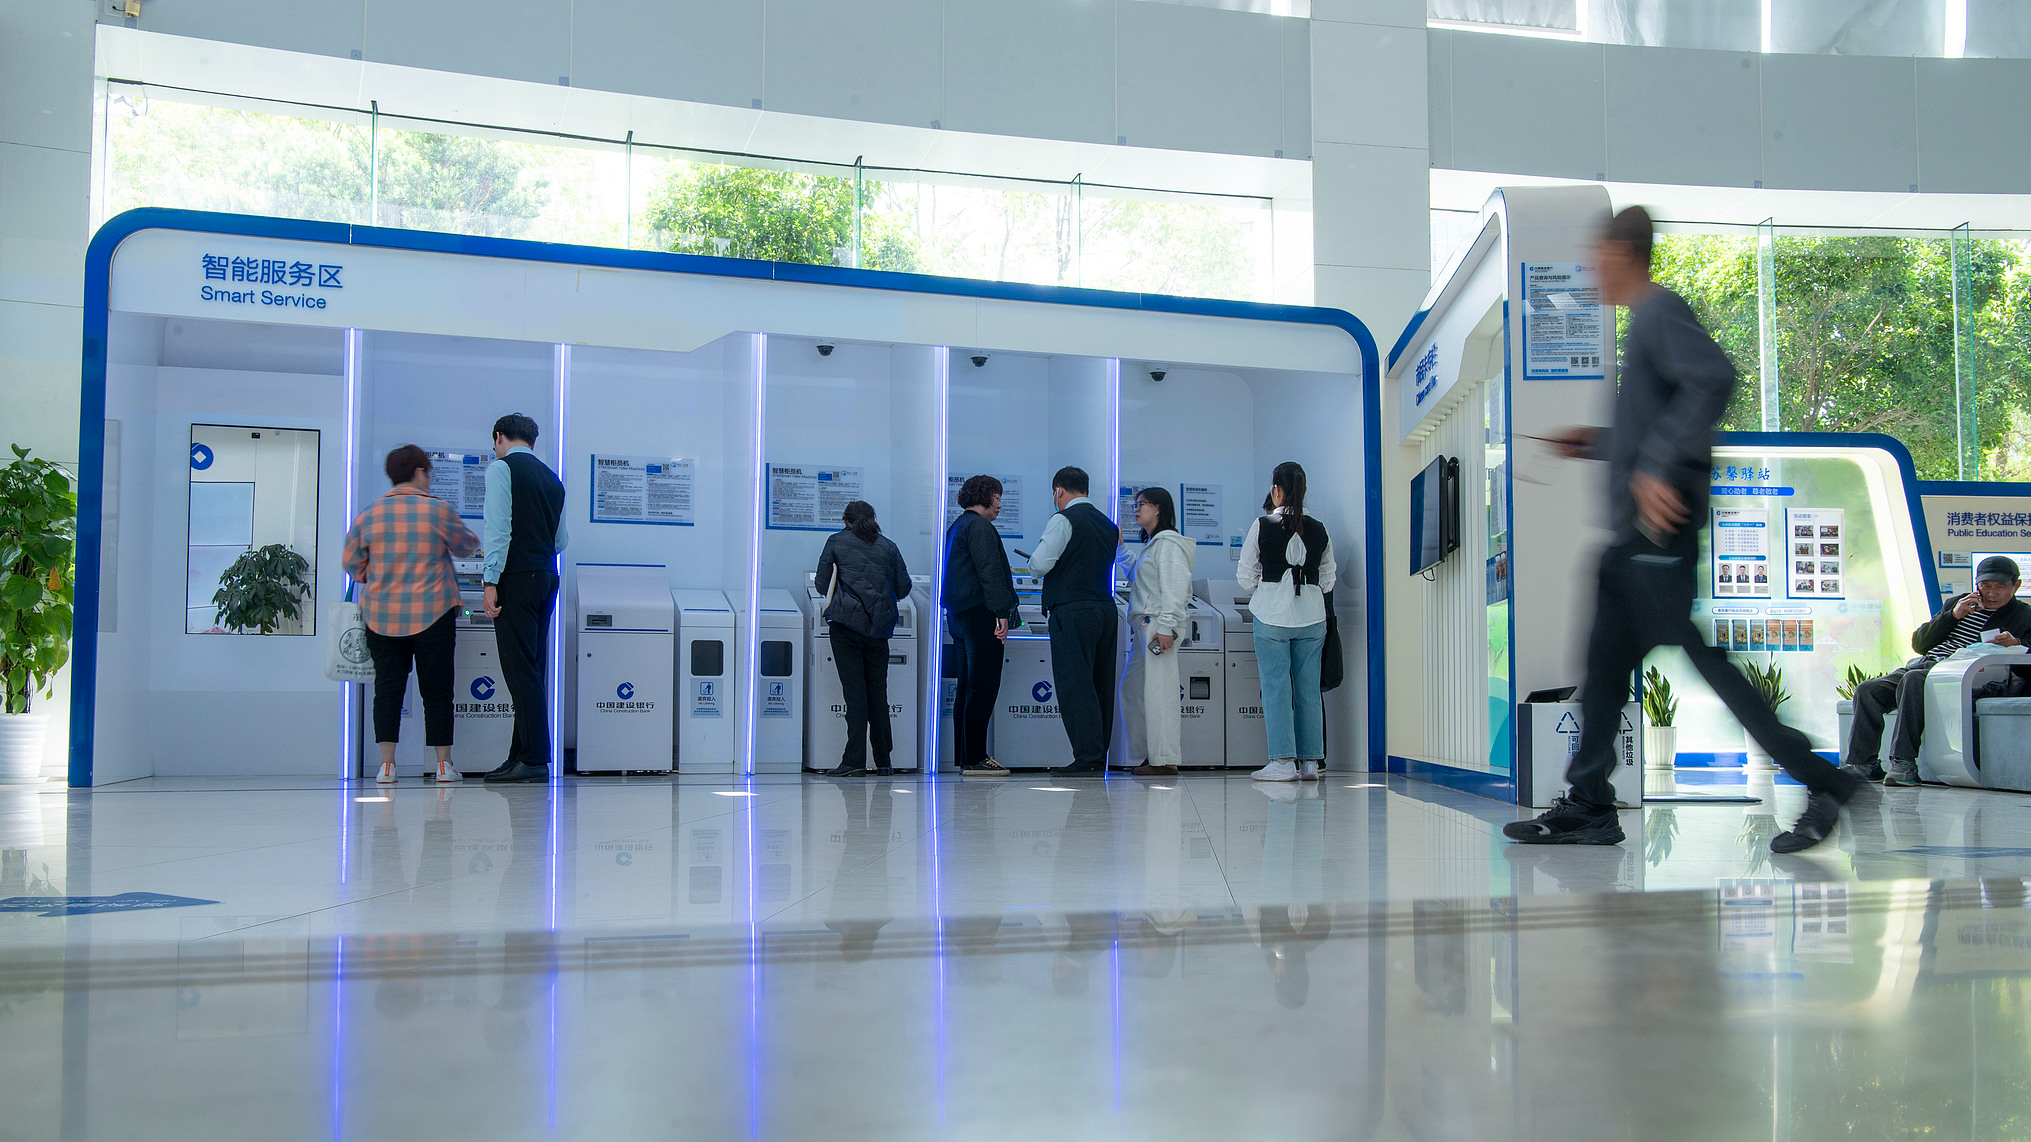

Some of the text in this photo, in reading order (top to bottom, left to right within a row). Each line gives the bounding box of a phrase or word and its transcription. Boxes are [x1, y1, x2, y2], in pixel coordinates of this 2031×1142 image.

[202, 253, 343, 289] 智能服务区
[200, 285, 327, 309] Smart Service
[598, 459, 629, 467] 智慧柜员机
[1712, 466, 1770, 481] 苏馨驿站
[1947, 528, 1974, 537] Public
[1976, 528, 2018, 537] Education
[596, 701, 655, 709] 中国建设银行
[1625, 736, 1634, 766] 其他垃圾
